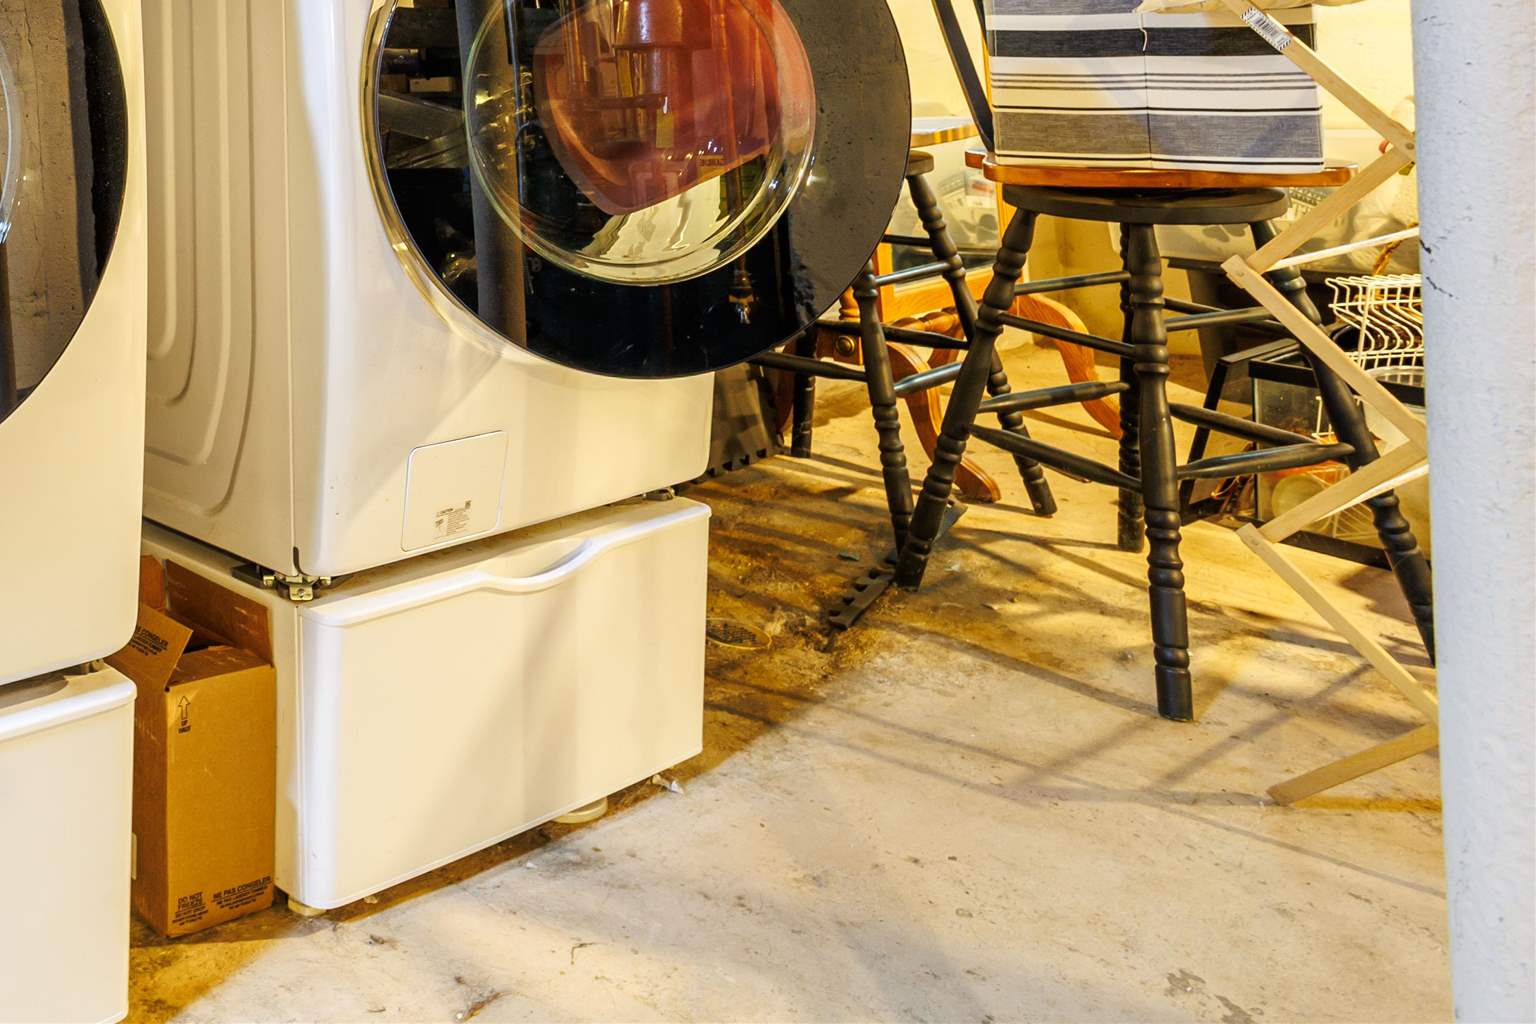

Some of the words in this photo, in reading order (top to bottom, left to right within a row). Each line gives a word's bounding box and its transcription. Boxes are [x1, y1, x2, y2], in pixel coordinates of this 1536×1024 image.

[223, 887, 236, 897] PAS
[237, 875, 272, 893] CONGELER
[177, 896, 189, 905] DO
[189, 891, 203, 902] NOT
